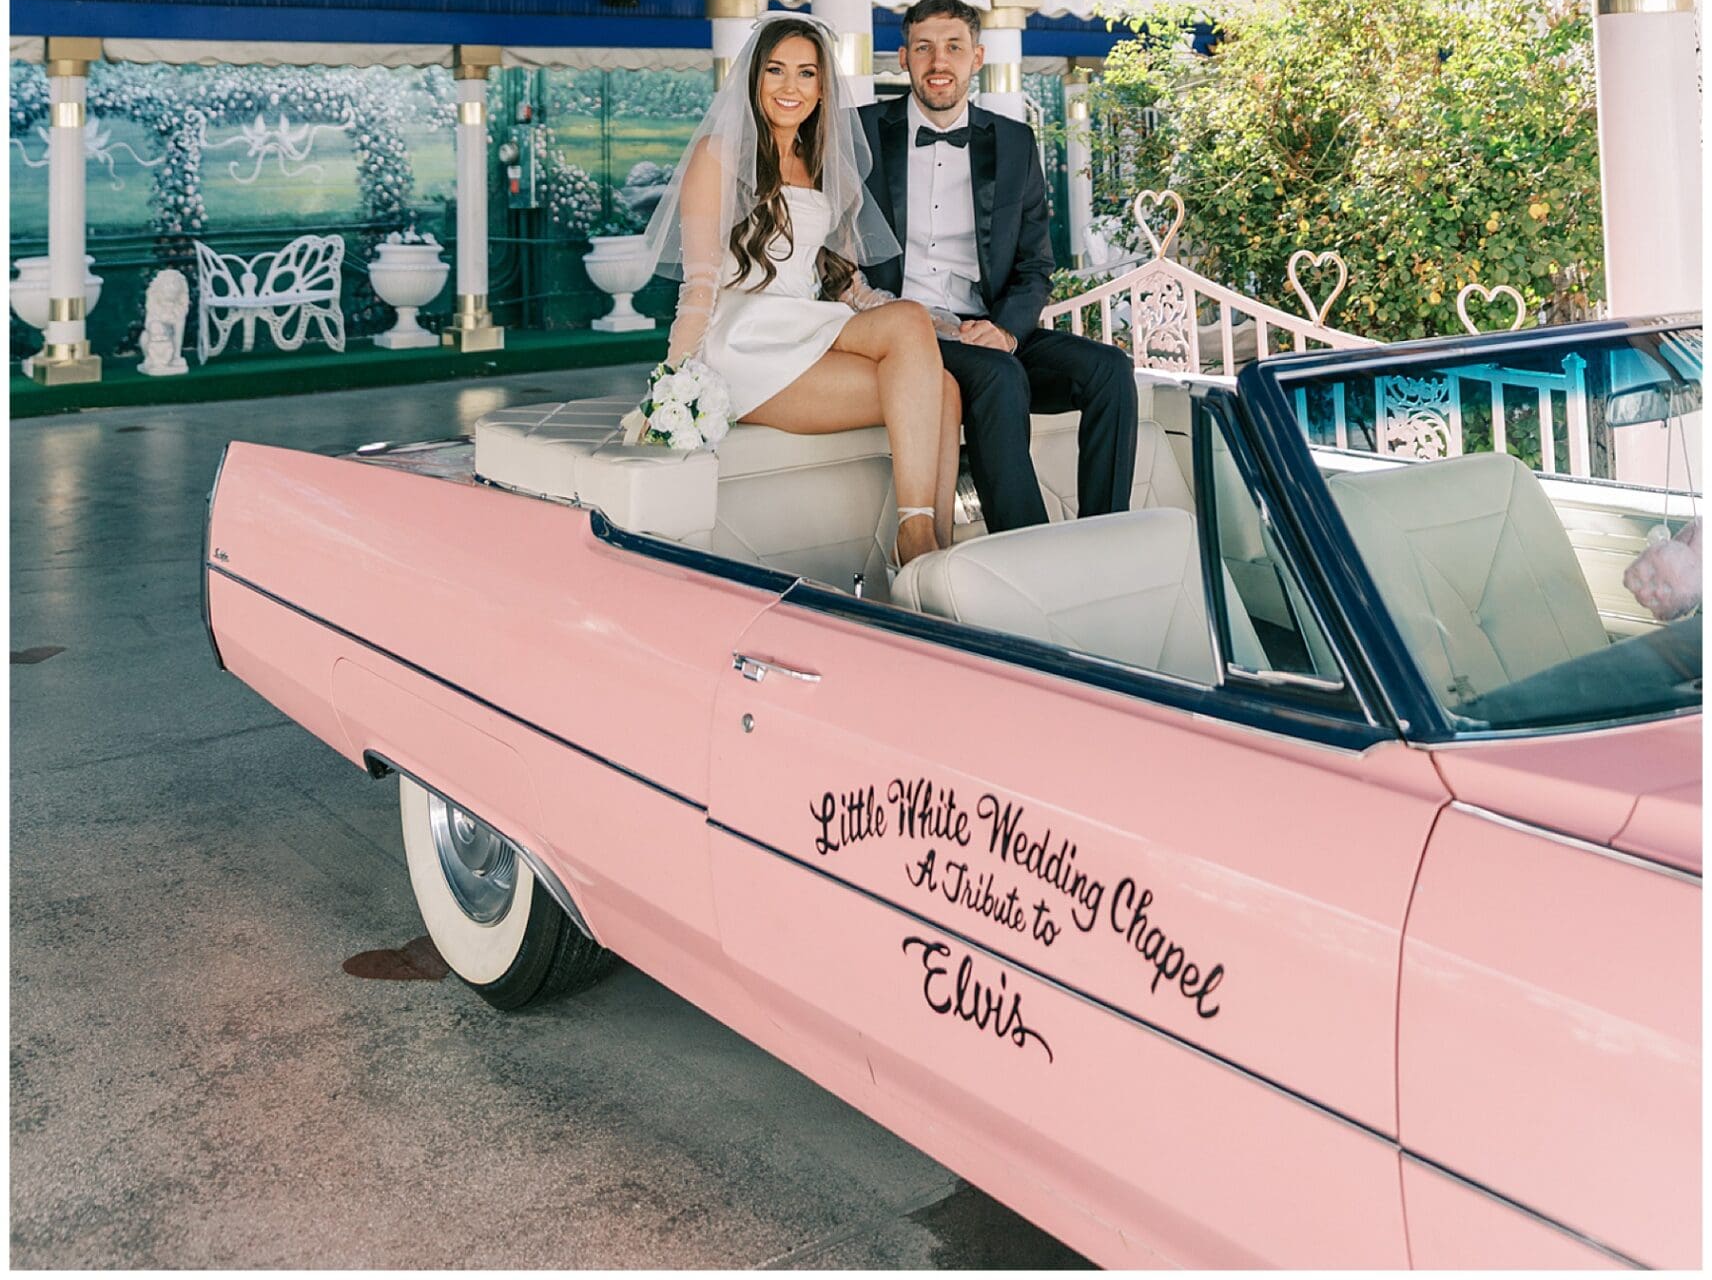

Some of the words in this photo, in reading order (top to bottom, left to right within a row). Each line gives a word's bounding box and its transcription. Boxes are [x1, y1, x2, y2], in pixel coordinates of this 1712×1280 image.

[810, 785, 888, 854] Little
[887, 778, 971, 846] White
[977, 794, 1104, 932] Wedding
[1110, 877, 1225, 1019] Chapel
[906, 849, 937, 892] A
[942, 861, 1027, 932] Tribute
[1033, 899, 1061, 946] to
[903, 936, 1053, 1064] Elvis
